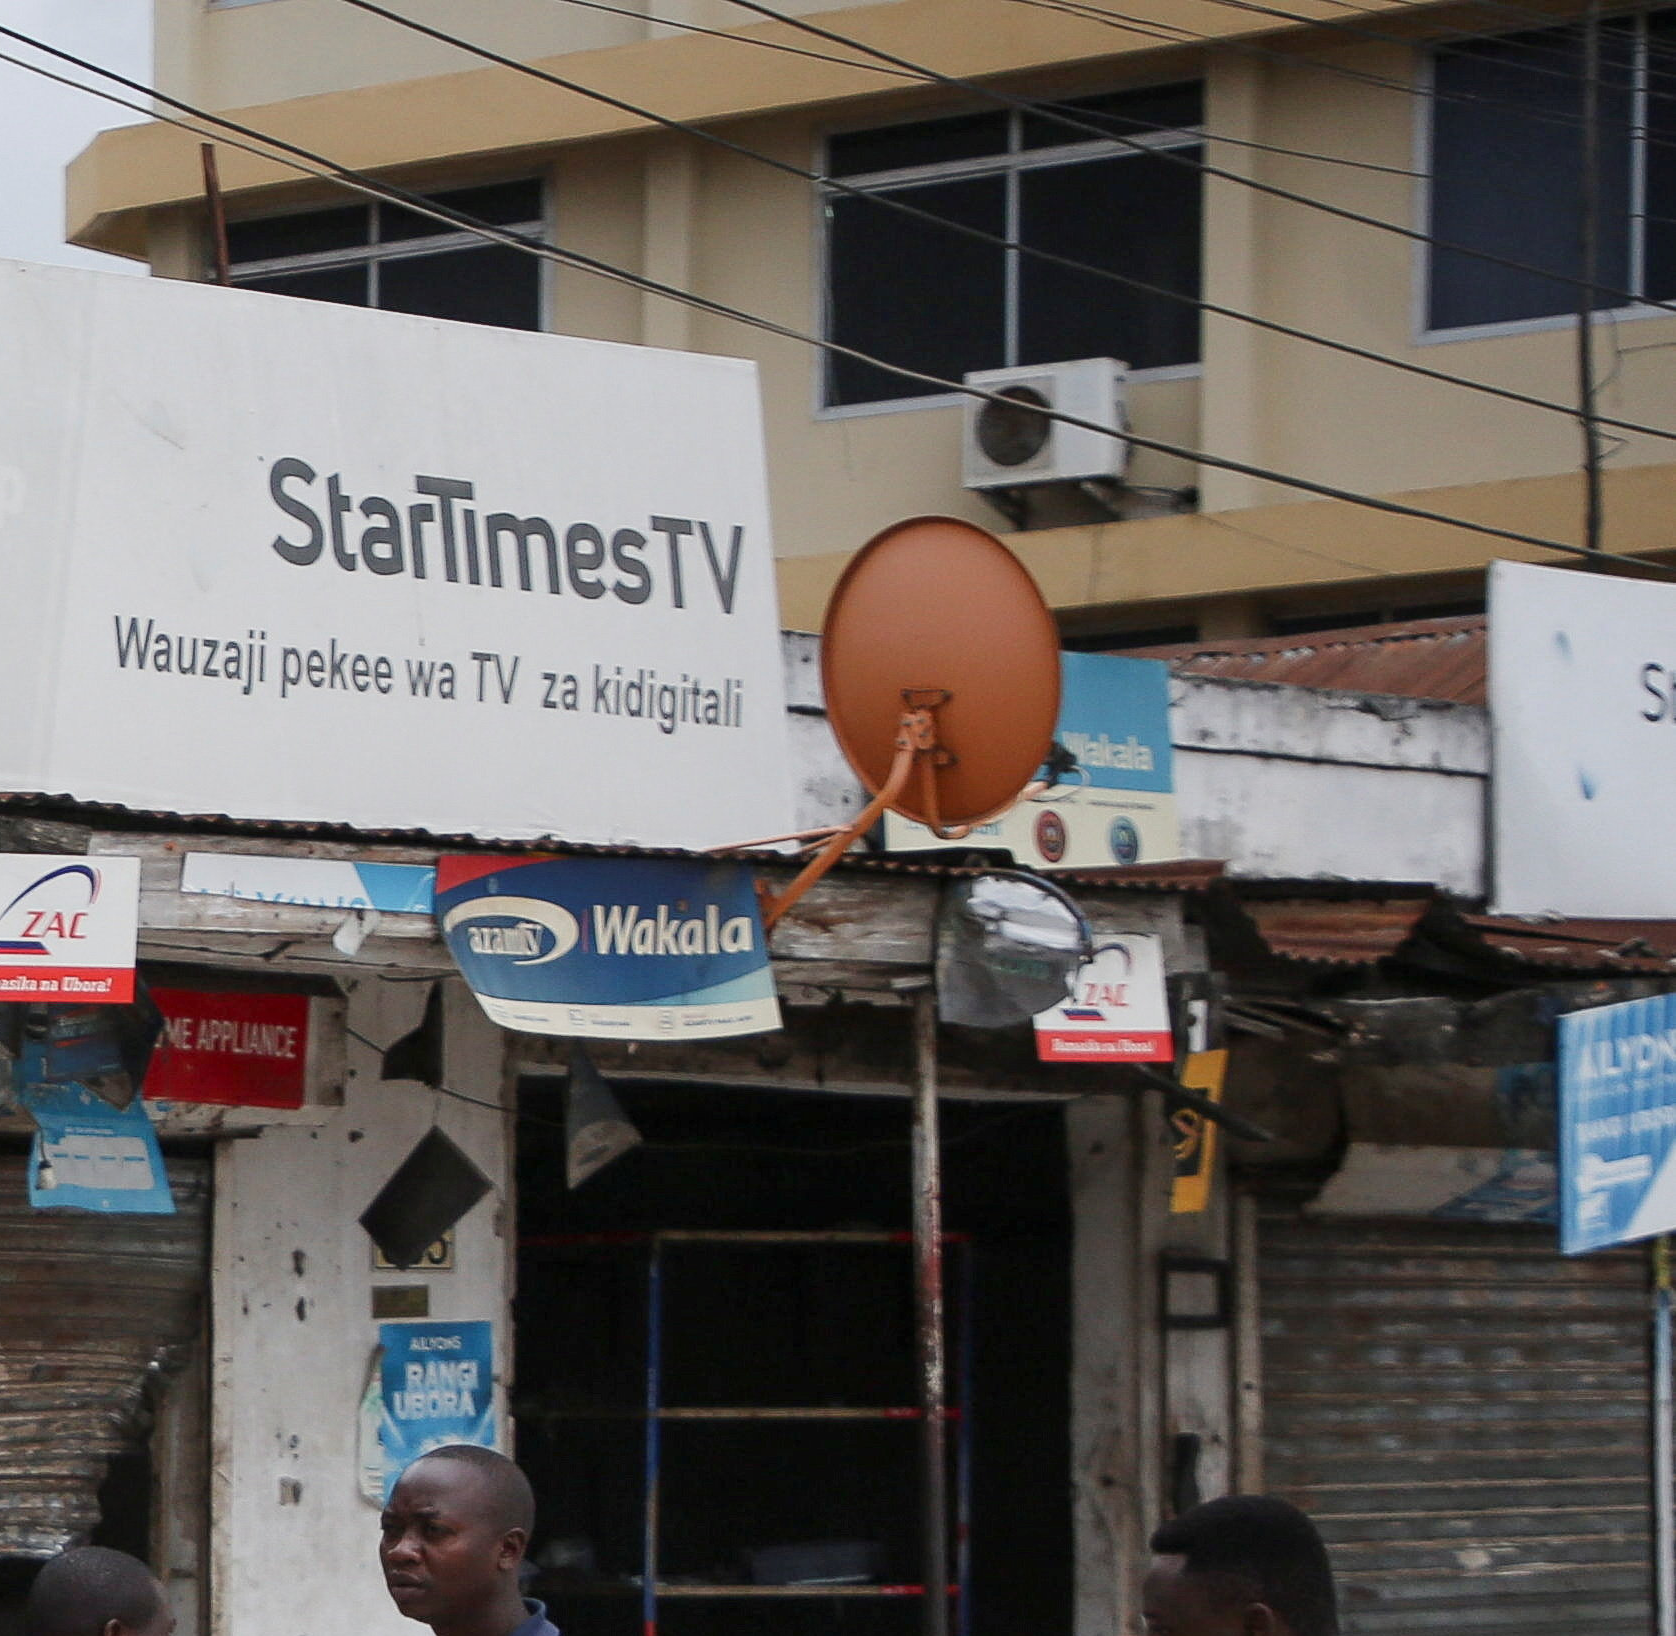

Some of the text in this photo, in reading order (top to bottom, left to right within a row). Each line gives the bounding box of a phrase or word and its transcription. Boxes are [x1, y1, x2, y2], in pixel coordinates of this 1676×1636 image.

[269, 455, 745, 616] StarTimesTV
[114, 613, 745, 735] Wauzaji pekee wa TV za kidigitali
[1061, 731, 1154, 771] Wakala
[19, 910, 89, 940] ZAC
[592, 904, 754, 956] Wakala
[38, 979, 60, 992] na
[197, 1018, 298, 1059] APPLIANCE
